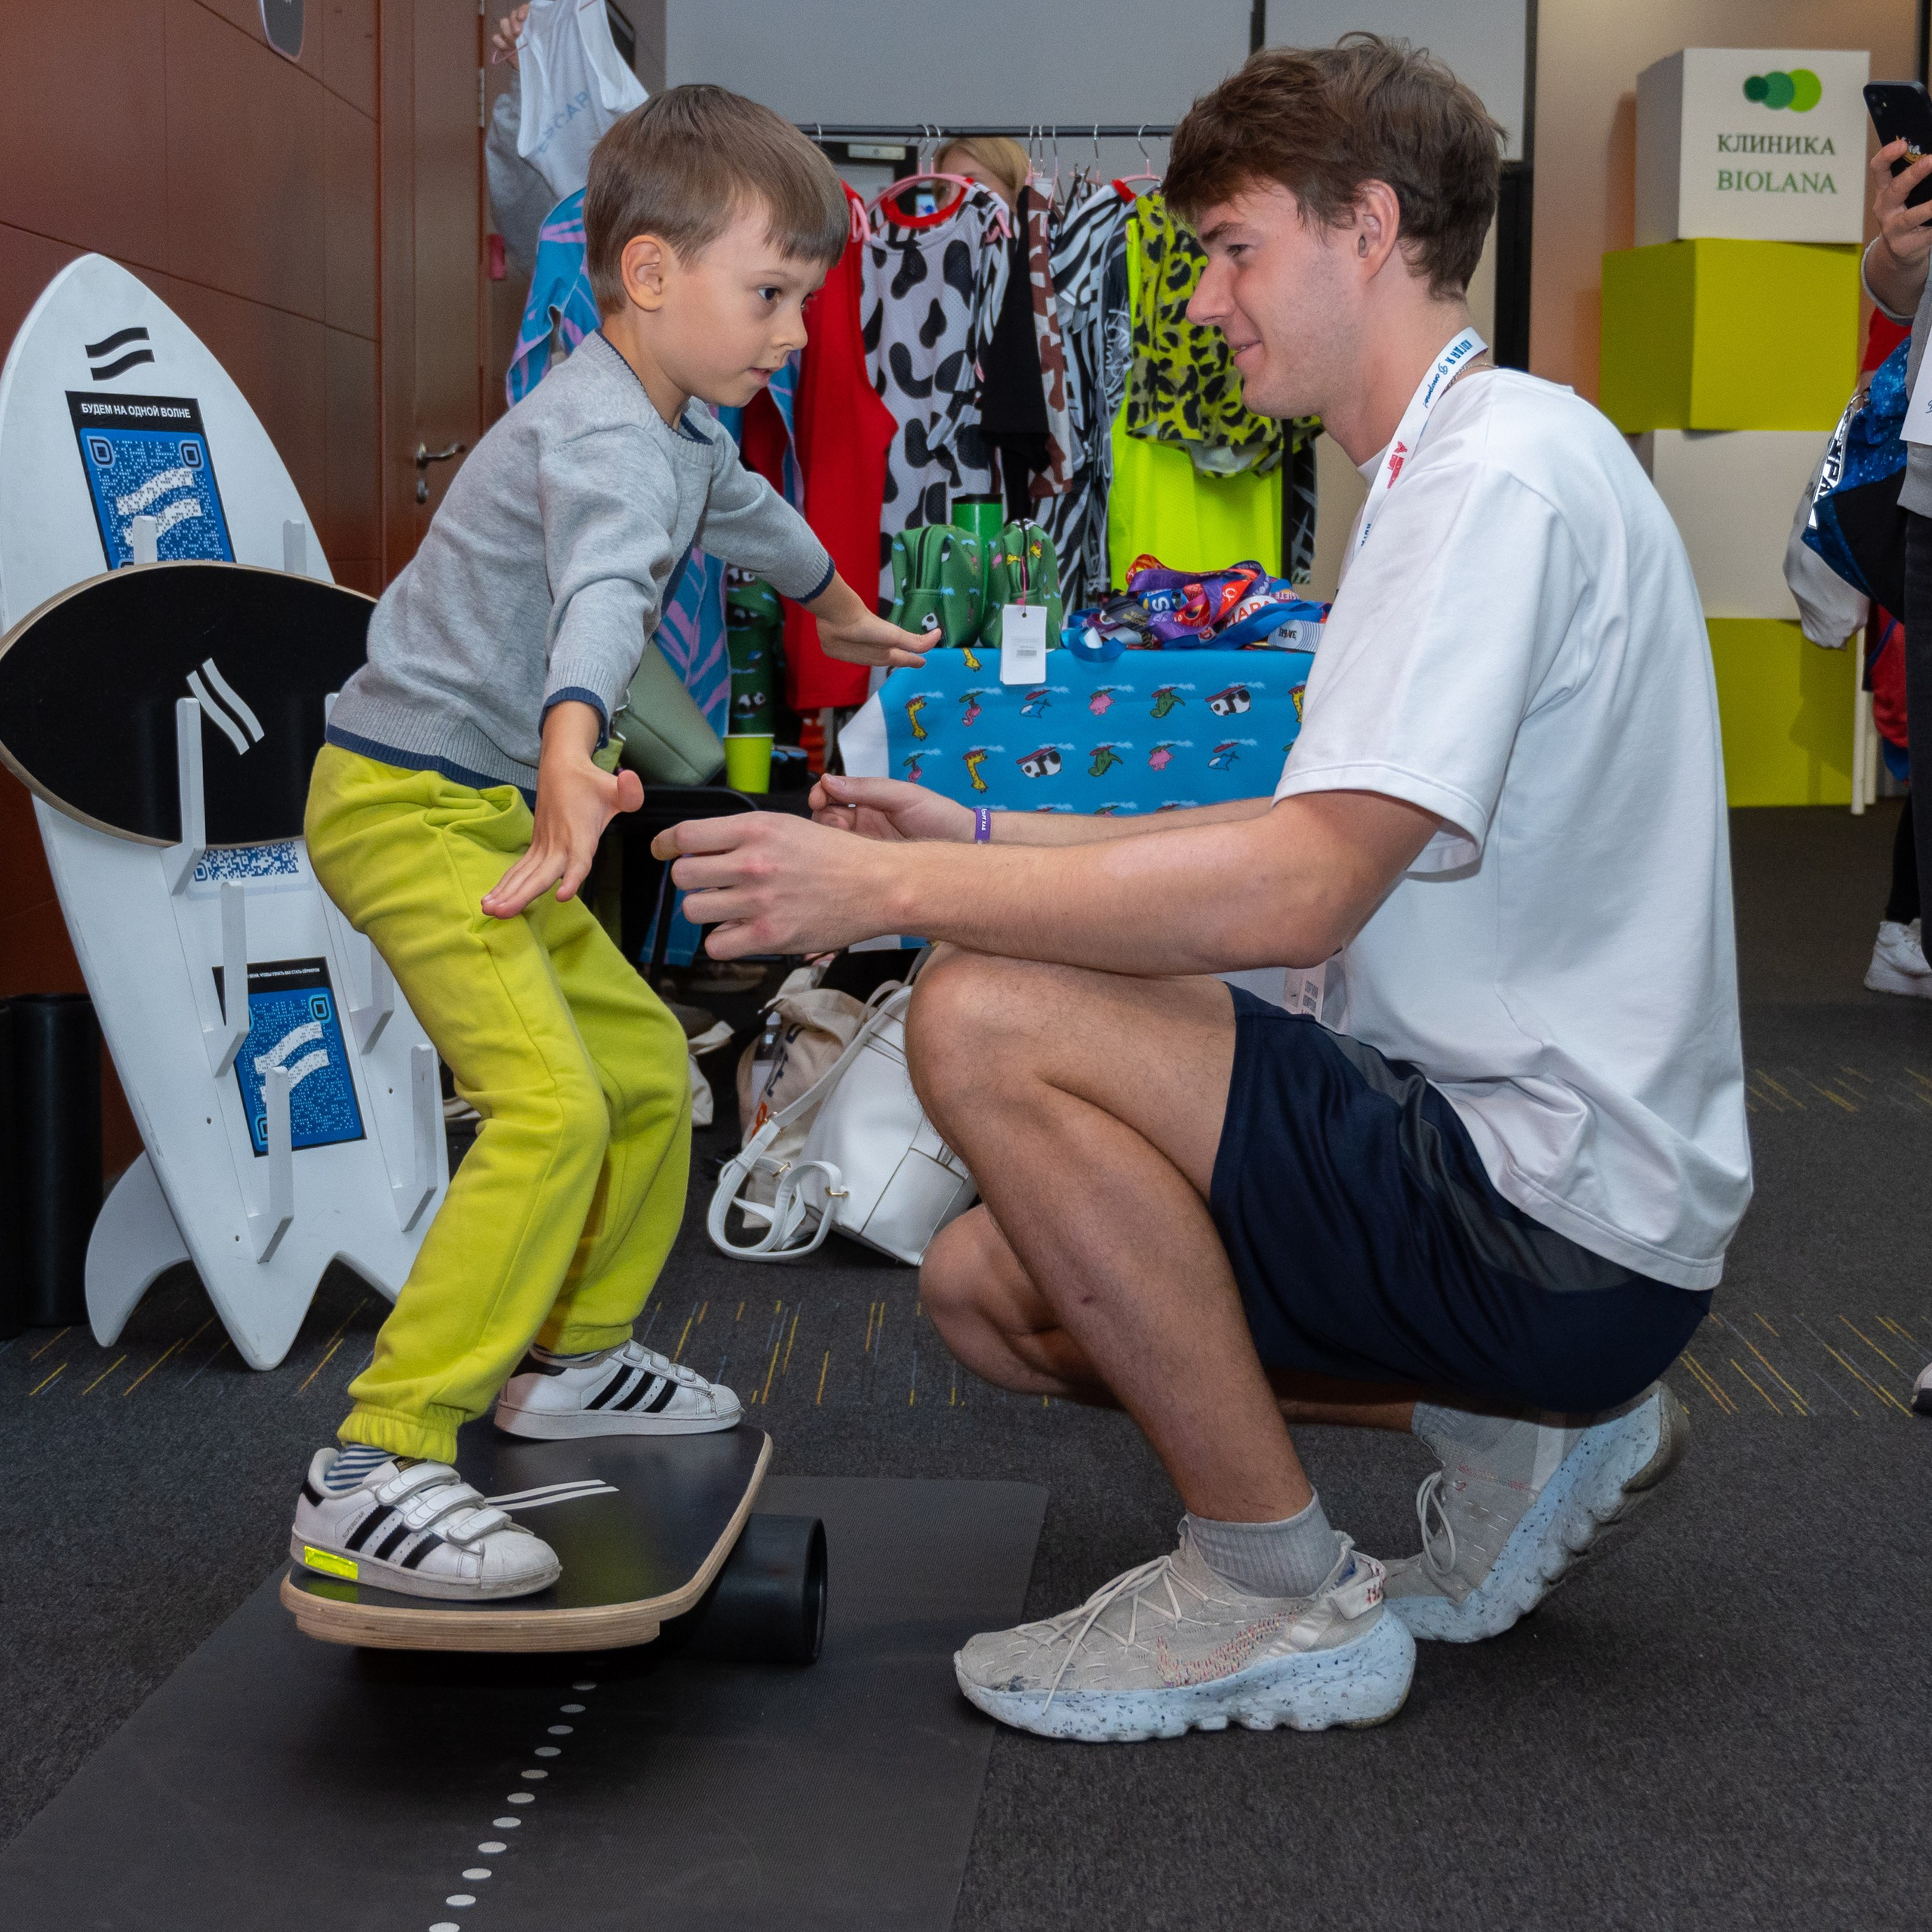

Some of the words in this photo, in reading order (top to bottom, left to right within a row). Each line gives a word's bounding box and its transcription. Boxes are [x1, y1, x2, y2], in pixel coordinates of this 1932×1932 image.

[1718, 134, 1835, 155] КЛИНИКА
[1718, 170, 1837, 194] BIOLANA
[1451, 340, 1472, 359] КОГДА
[1445, 355, 1455, 365] Я
[82, 403, 112, 415] БУДЕМ
[114, 405, 127, 415] НА
[128, 405, 159, 417] ОДНОЙ
[161, 408, 191, 419] ВОЛНЕ
[342, 1511, 365, 1540] SUPERSTAR
